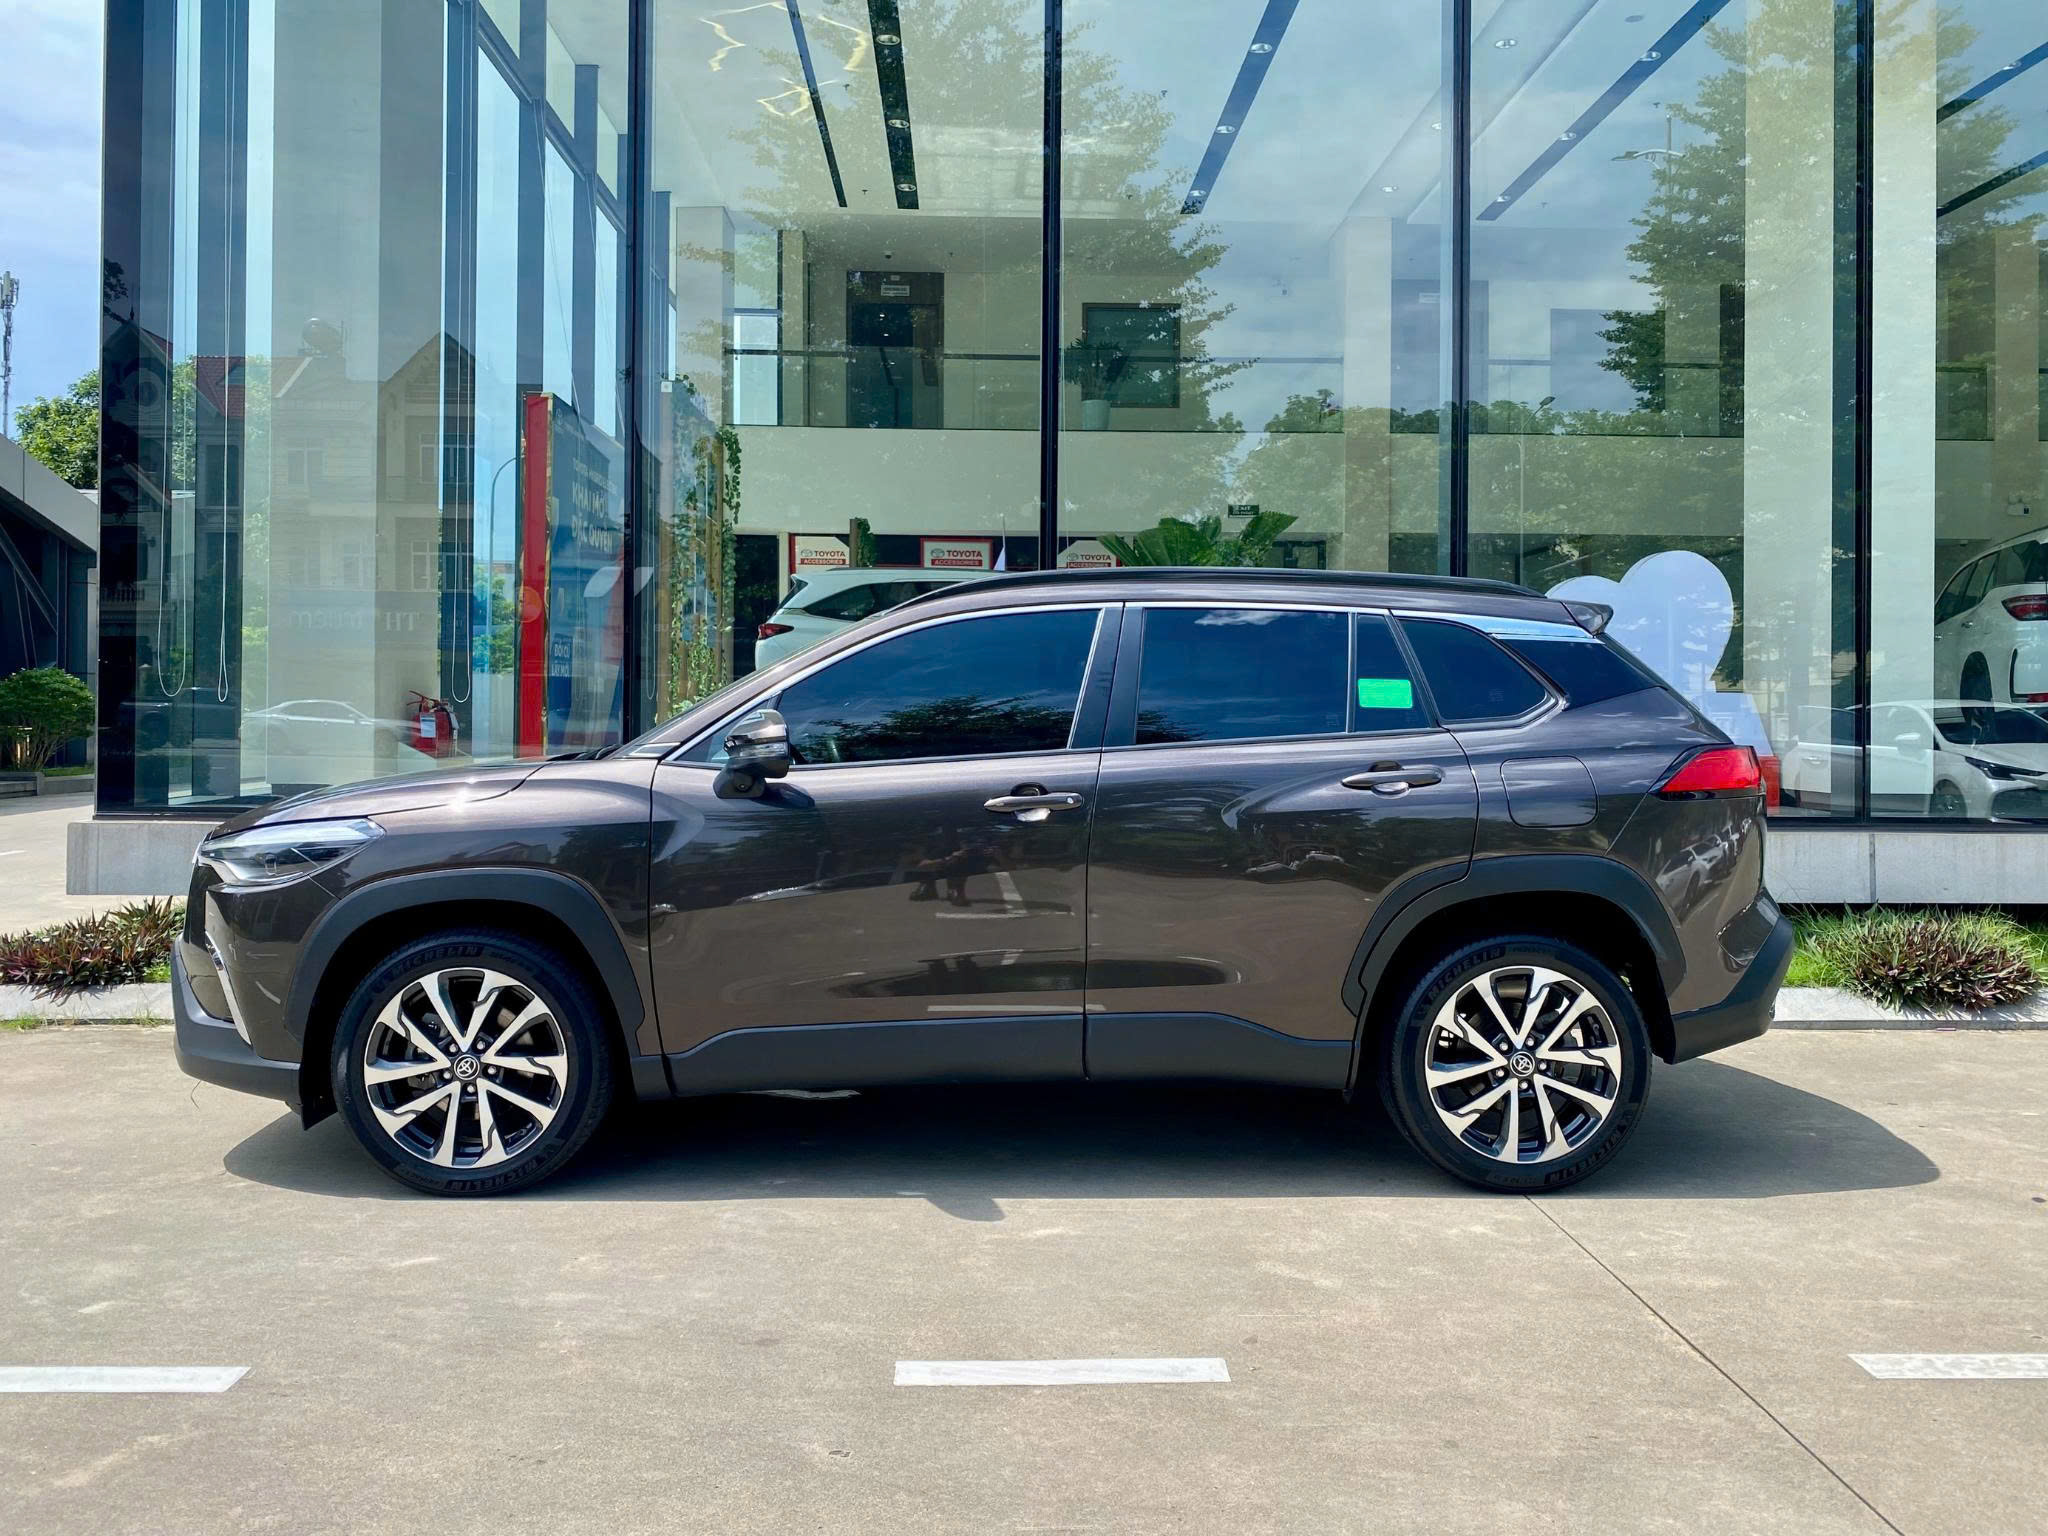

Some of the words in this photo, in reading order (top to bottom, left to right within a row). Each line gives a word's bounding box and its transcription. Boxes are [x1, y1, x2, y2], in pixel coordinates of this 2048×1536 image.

[815, 550, 846, 558] TOYOTA
[946, 550, 983, 558] TOYOTA
[392, 946, 477, 977] MICHELIN
[1427, 947, 1501, 1000] MICHELIN
